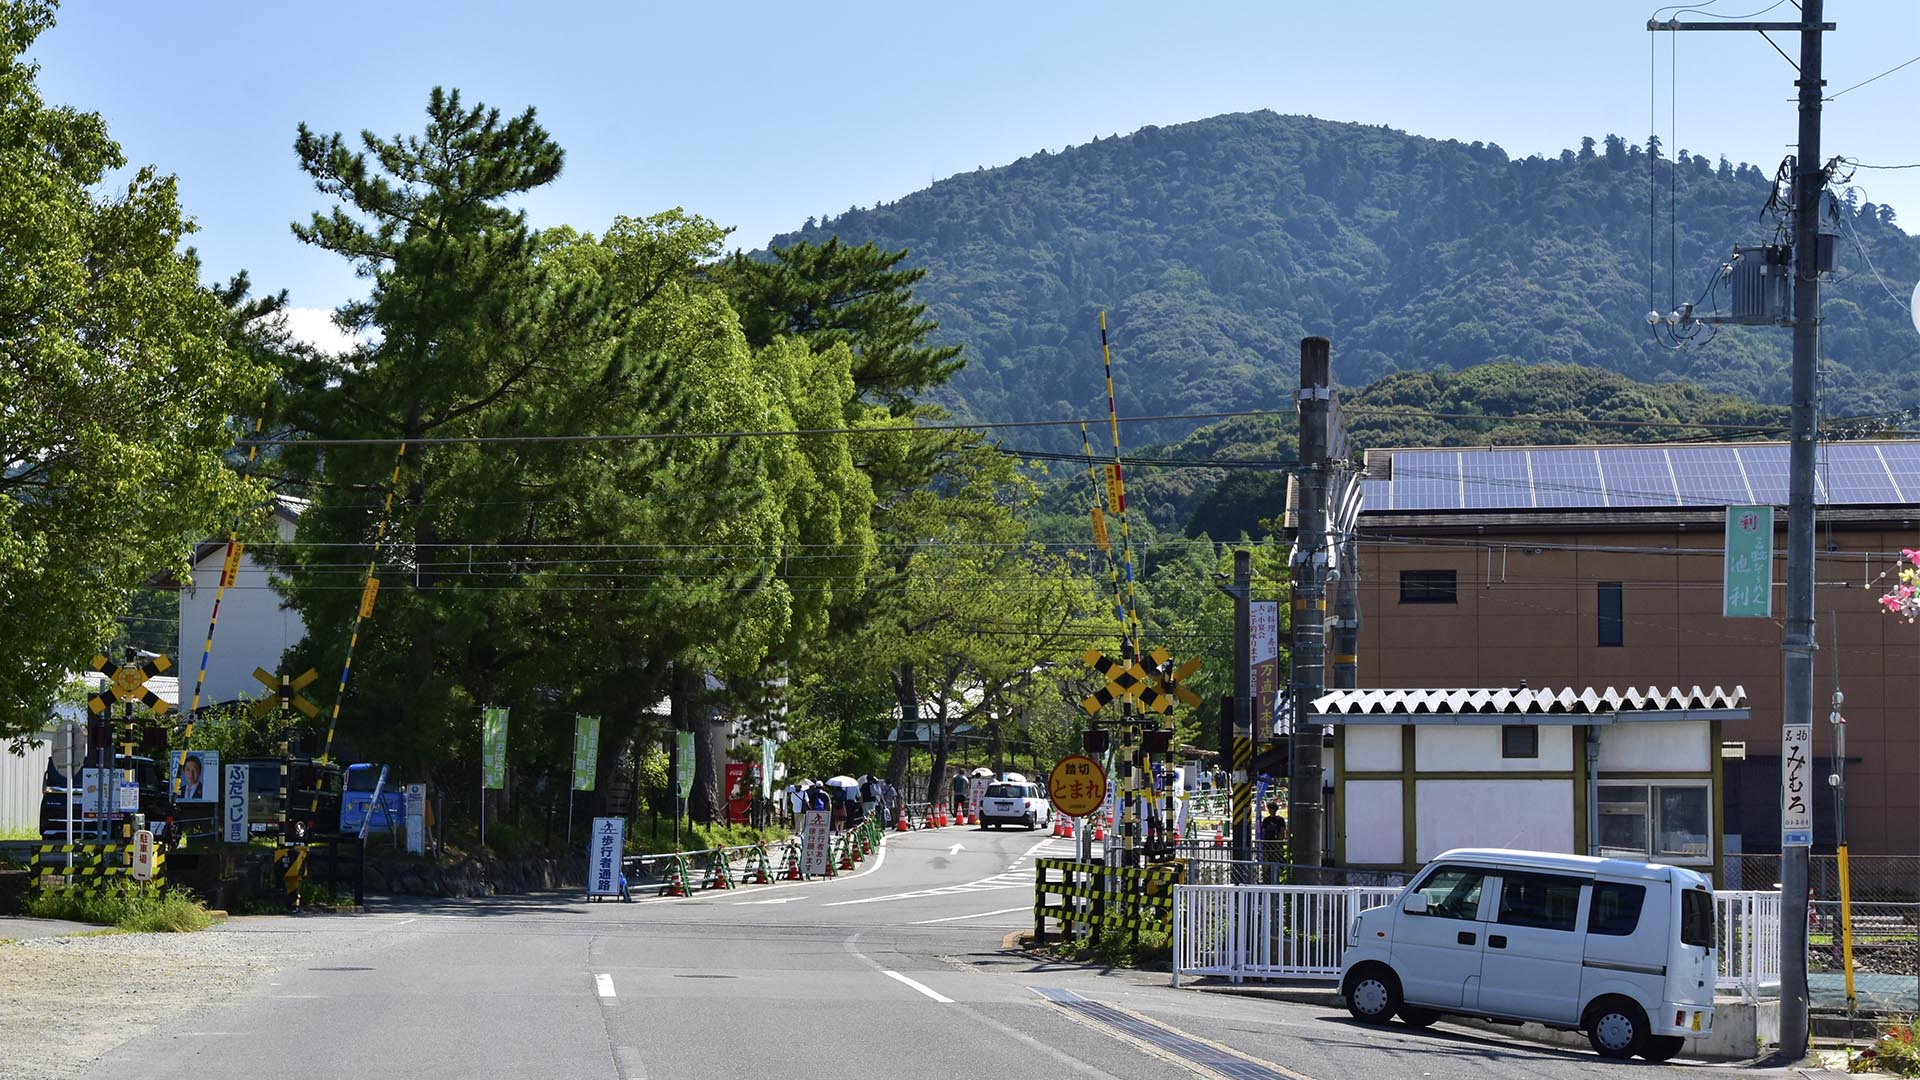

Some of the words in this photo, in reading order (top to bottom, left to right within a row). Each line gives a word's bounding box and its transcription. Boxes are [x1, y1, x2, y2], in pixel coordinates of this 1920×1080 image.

[1739, 514, 1759, 532] 利
[1729, 553, 1752, 608] 池利
[1259, 664, 1275, 739] 万直し本店
[1053, 780, 1101, 800] とまれ
[1065, 763, 1090, 776] 踏切
[1787, 745, 1806, 814] みむろ
[597, 835, 615, 892] 歩行者通路
